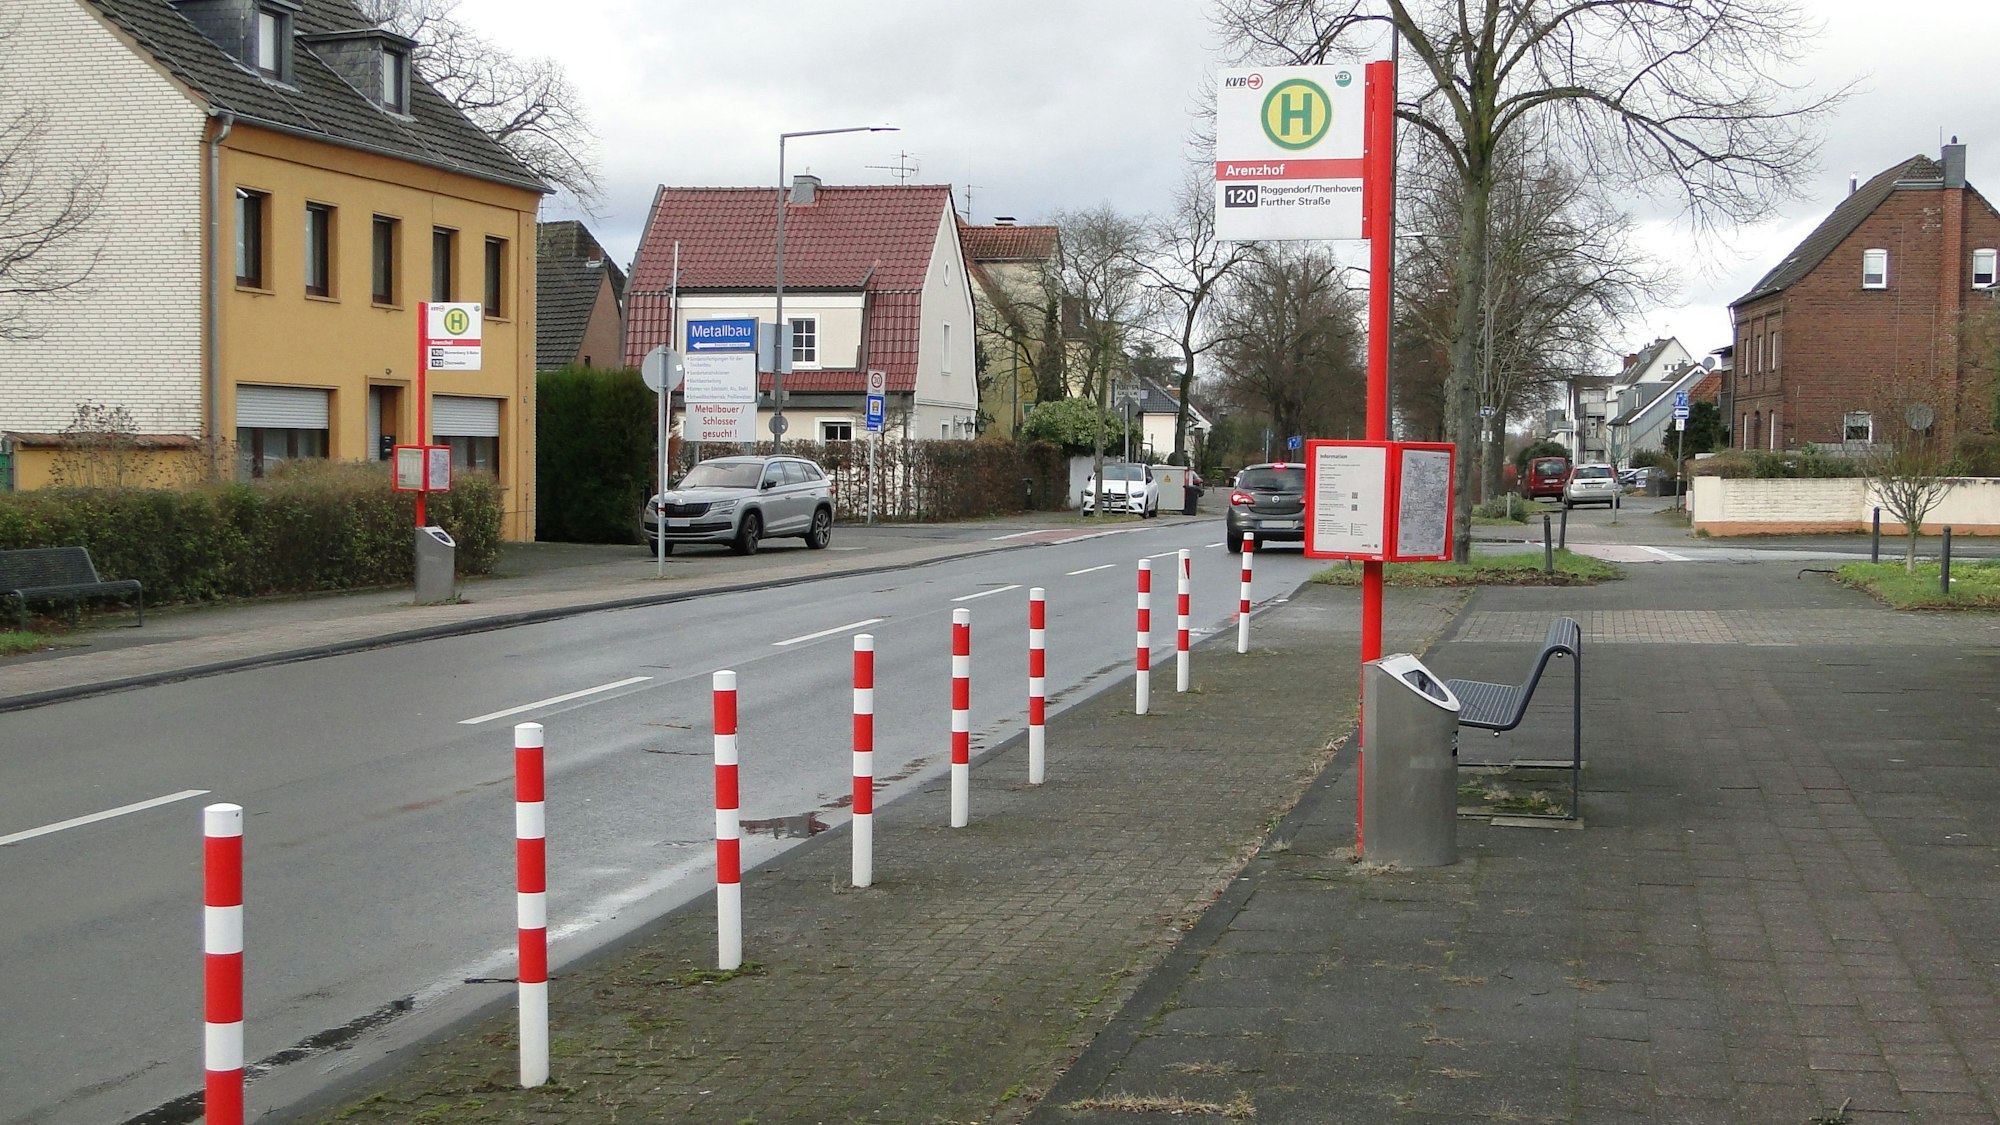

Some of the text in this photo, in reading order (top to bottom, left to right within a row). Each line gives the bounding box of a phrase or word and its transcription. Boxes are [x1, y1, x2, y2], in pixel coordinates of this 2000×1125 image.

[1225, 77, 1247, 87] KVB
[1281, 93, 1313, 136] H
[1225, 163, 1286, 177] Arenzhof
[1260, 184, 1363, 196] Roggendorf/Thenhoven
[1227, 189, 1257, 204] 120
[1260, 196, 1331, 206] Further Straße
[451, 313, 463, 330] H
[692, 324, 751, 338] Metallbau
[694, 404, 746, 414] Metallbauer /
[702, 416, 737, 426] Schlosser
[702, 428, 733, 440] gesucht
